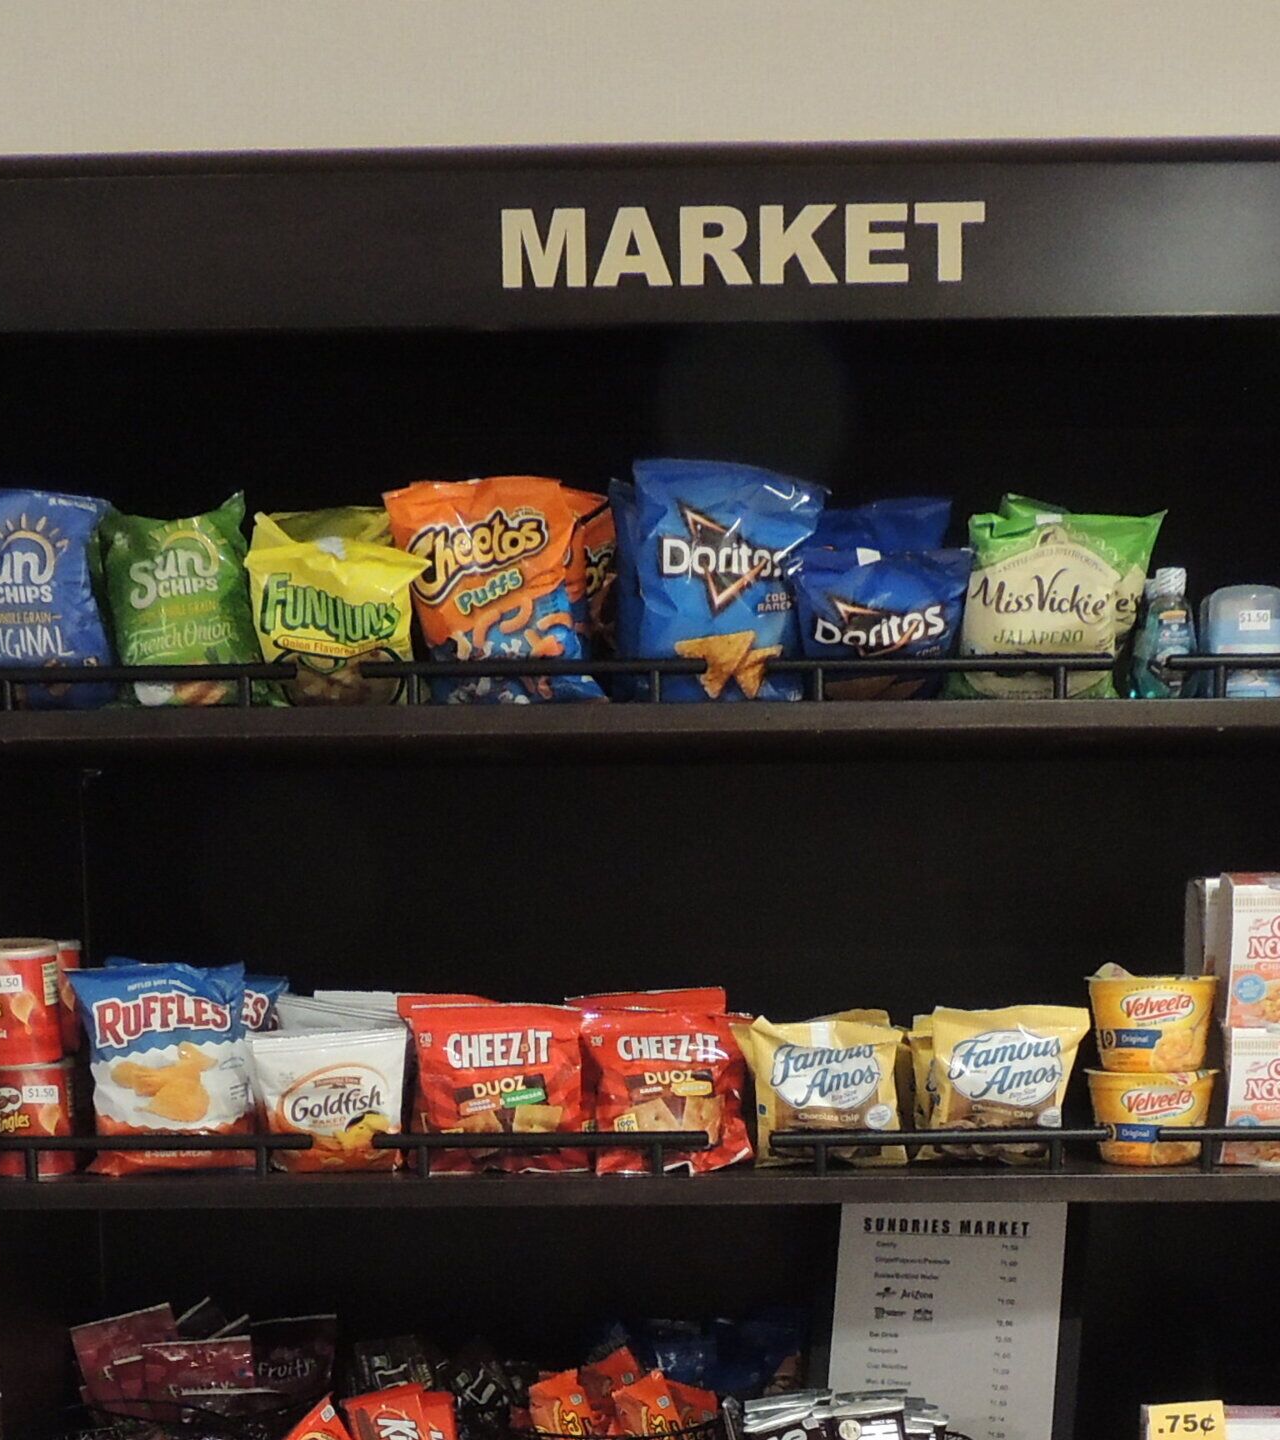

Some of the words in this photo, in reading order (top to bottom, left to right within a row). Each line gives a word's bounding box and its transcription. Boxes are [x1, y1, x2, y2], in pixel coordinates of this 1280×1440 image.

[501, 201, 986, 288] MARKET
[407, 509, 548, 605] Cheetos
[129, 550, 220, 608] Sun
[157, 576, 219, 599] CHIPS
[455, 569, 523, 615] Puffs
[815, 606, 945, 648] Doritos
[1239, 611, 1269, 623] $1.50
[94, 992, 231, 1047] RUFFLES
[1126, 994, 1193, 1018] Velveeta
[770, 1043, 875, 1087] Famous
[948, 1037, 1062, 1080] Famous
[472, 1075, 526, 1098] DUOZ
[643, 1070, 695, 1085] DUOZ
[794, 1065, 880, 1107] Amos
[970, 1065, 1062, 1099] Amos
[28, 1087, 55, 1098] $1.50
[290, 1084, 382, 1122] Goldfish
[1127, 1090, 1193, 1113] Velveeta
[1121, 1129, 1150, 1139] Original
[864, 1217, 951, 1234] SUNDRIES
[960, 1220, 1030, 1236] MARKET
[258, 1357, 312, 1378] Fruity
[1158, 1414, 1216, 1436] .75¢
